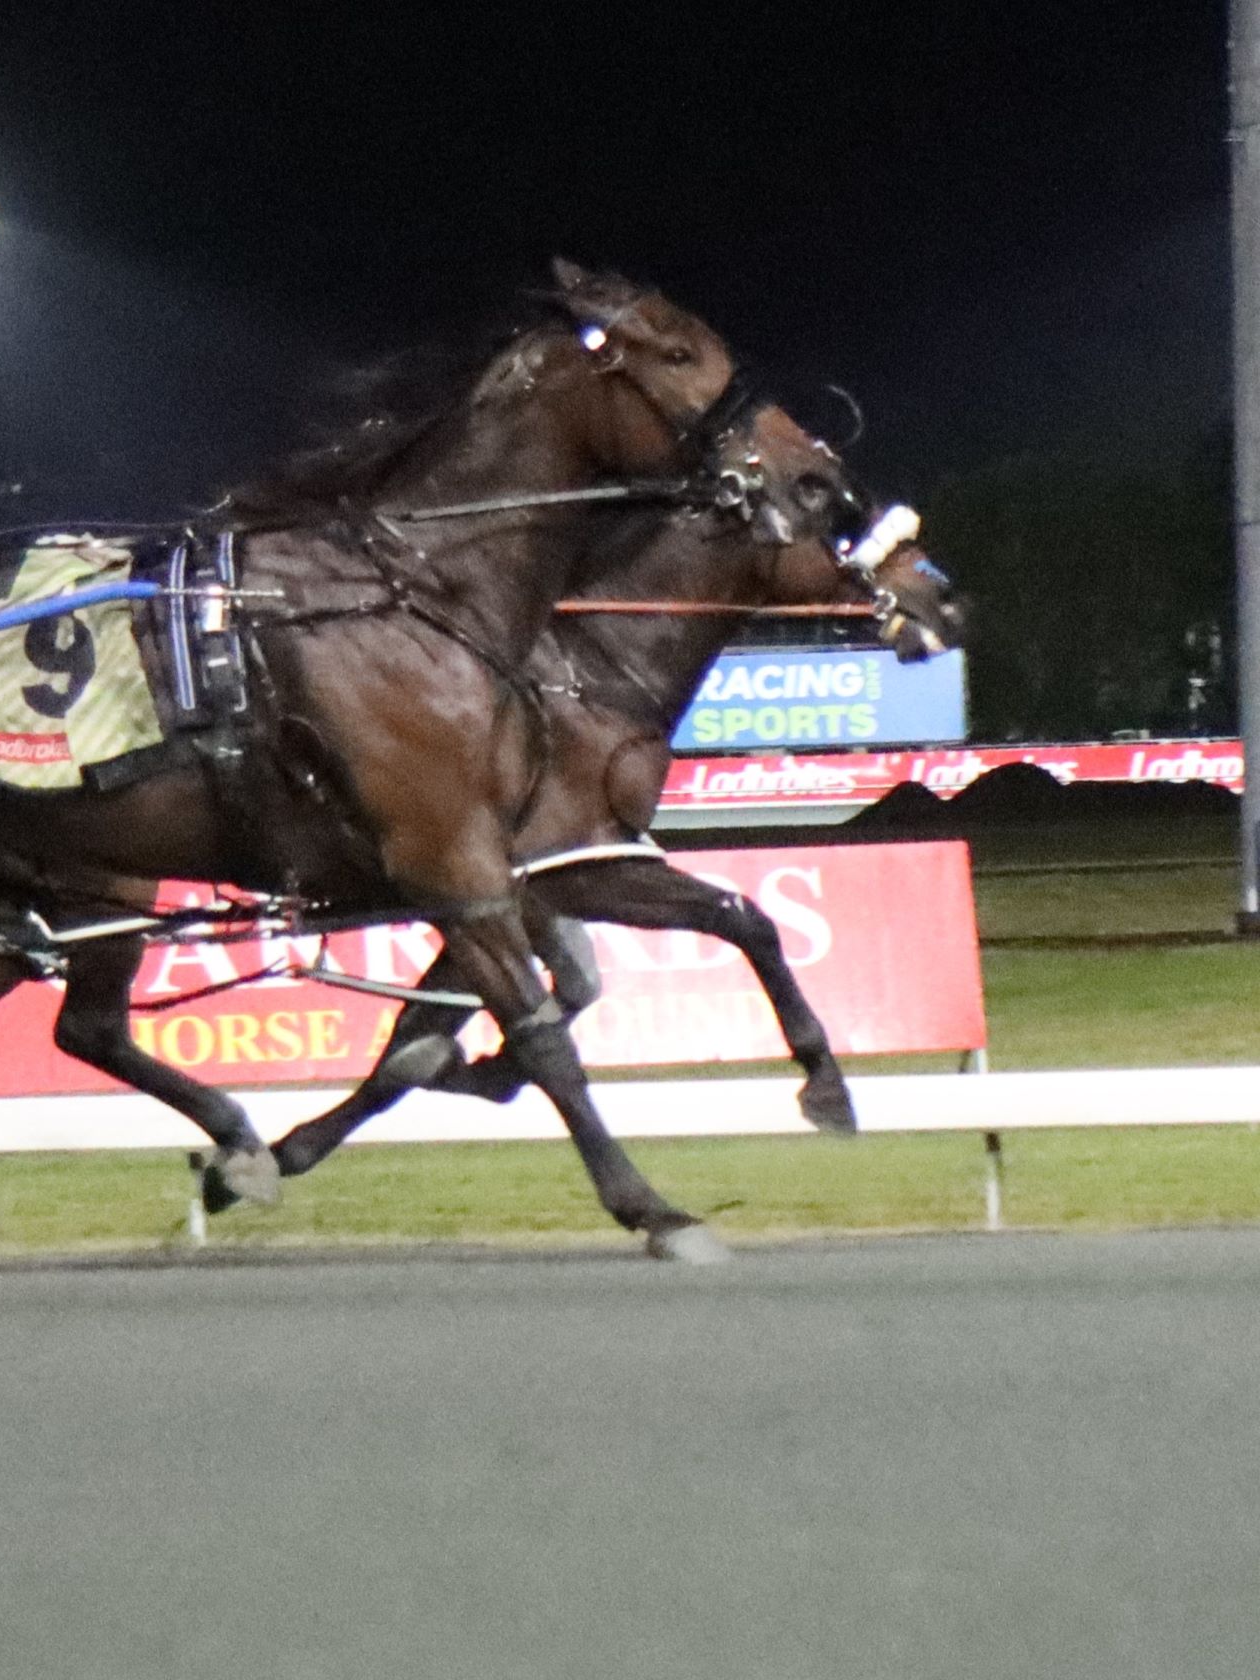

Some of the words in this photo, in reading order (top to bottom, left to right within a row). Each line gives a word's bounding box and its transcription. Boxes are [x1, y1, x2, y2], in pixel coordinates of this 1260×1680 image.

[23, 606, 96, 719] 9
[695, 662, 865, 701] RACING
[693, 703, 878, 743] SPORTS
